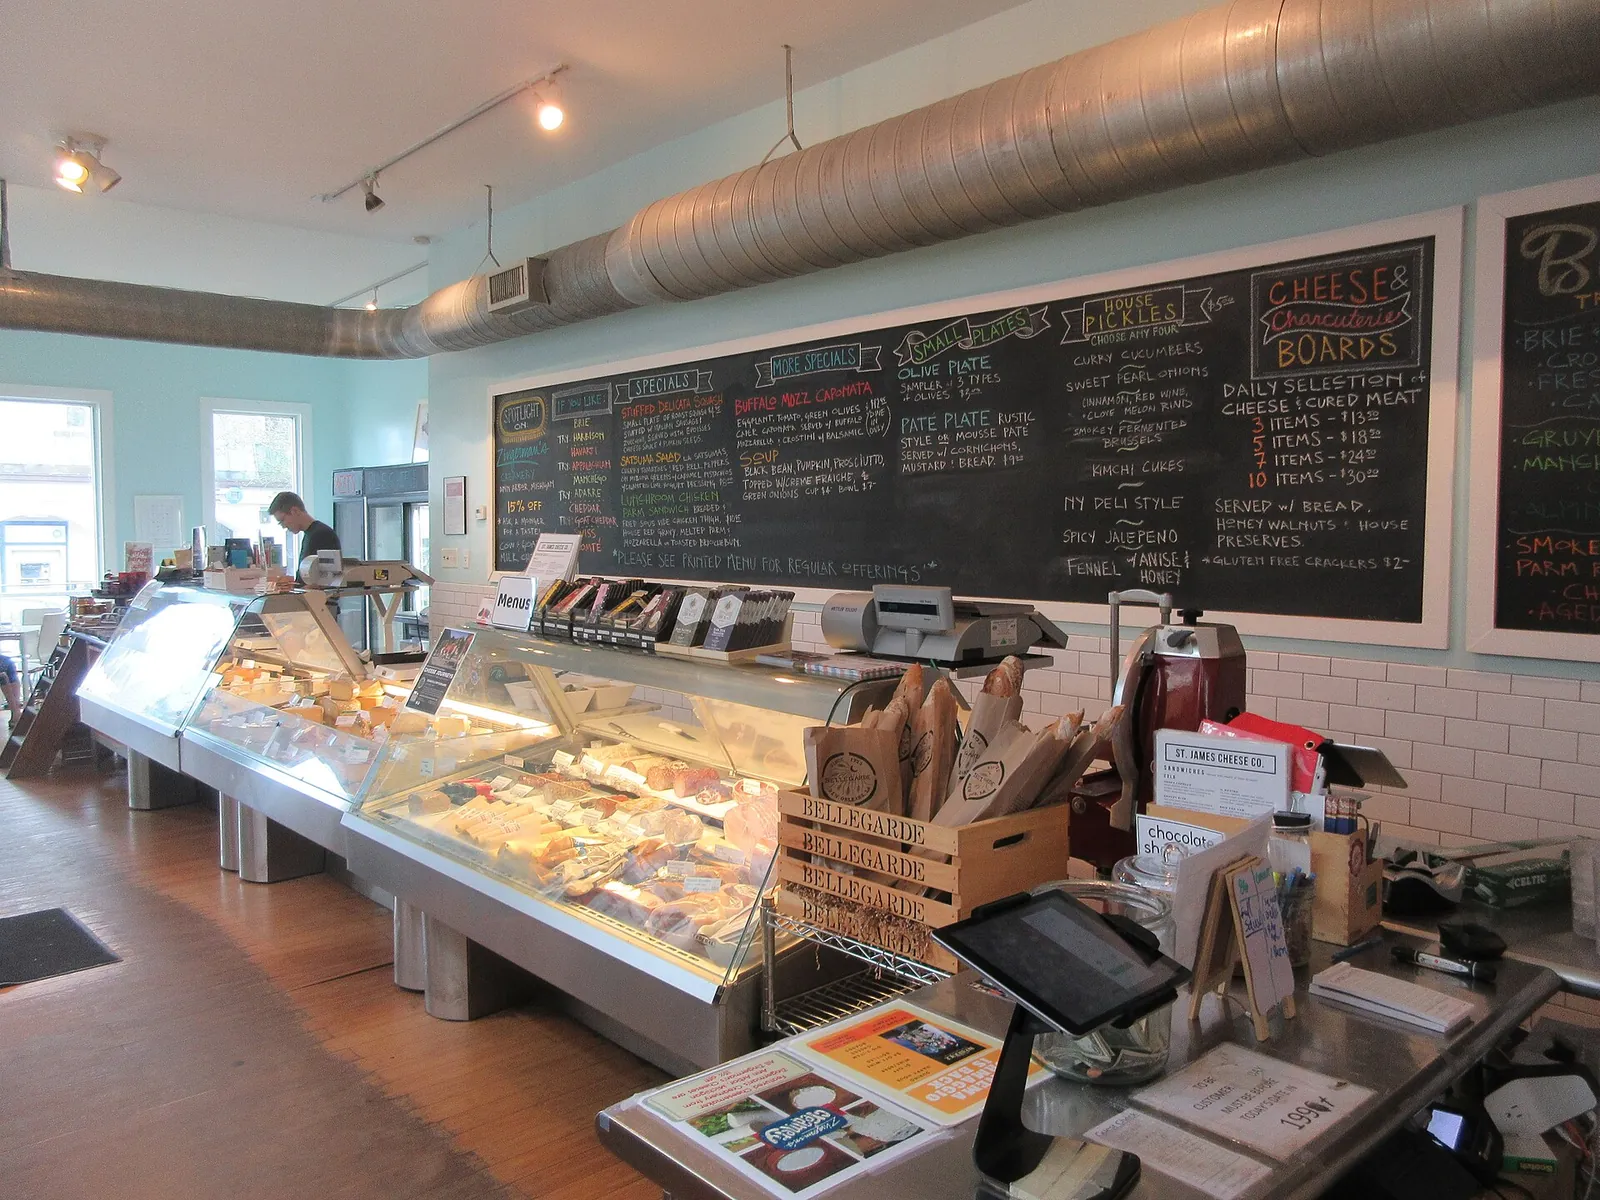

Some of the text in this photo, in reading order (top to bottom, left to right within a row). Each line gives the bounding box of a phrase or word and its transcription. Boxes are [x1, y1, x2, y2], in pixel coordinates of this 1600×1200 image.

[1270, 265, 1408, 305] CHEESE &
[1104, 294, 1153, 312] HOUSE
[1086, 304, 1176, 330] PICKLES
[914, 312, 1026, 361] SMALL PLATES
[1091, 325, 1179, 346] CHOOSE ANY FOUR
[1074, 342, 1204, 366] CURRY CUCUMBERS
[1278, 333, 1397, 368] BOARDS
[773, 348, 855, 375] MORE SPECIALS
[898, 356, 991, 380] OLIVE PLATE
[636, 373, 689, 395] SPECIALS
[900, 374, 1000, 393] SAMPLER 3 TYPES
[1066, 367, 1208, 392] SWEET PEARL ONIONS
[1224, 373, 1403, 397] DAILY SELECTION
[558, 401, 565, 409] IF
[735, 382, 872, 415] BUFFALO MOZZ CAPONATA
[915, 390, 950, 402] OLIVES
[1135, 393, 1155, 403] RED
[1221, 388, 1423, 416] CHEESE CURED MEAT
[504, 402, 540, 423] SPOTLIGHT
[621, 404, 655, 419] STUFFED
[658, 398, 691, 413] DELICATA
[805, 405, 860, 420] GREEN OLIVES
[1125, 400, 1192, 415] MELON RIND
[902, 410, 1035, 434] PATÉ PLATE RUSTIC
[1073, 420, 1187, 436] SMOKEY FERMENTED
[1252, 413, 1320, 433] 3 ITEMS
[783, 429, 863, 444] CROSTINI BALSAMIC
[901, 435, 932, 448] STYLE
[956, 428, 997, 442] MOUSSE
[1104, 434, 1163, 448] BRUSSELS
[1252, 432, 1320, 452] 5 ITEMS
[620, 452, 681, 466] SATSUMA SALAD
[740, 450, 778, 467] SOUP
[902, 450, 934, 461] SERVED
[1254, 450, 1323, 469] 7 ITEMS
[744, 465, 768, 477] BLACK
[902, 462, 946, 472] MUSTARD
[1092, 460, 1184, 477] KIMCHI CUKES
[742, 479, 772, 490] TOPPED
[1249, 470, 1324, 488] 10 ITEMS
[679, 492, 720, 502] CHICKEN
[742, 489, 766, 501] GREEN
[769, 489, 799, 499] ONIONS
[1064, 496, 1183, 511] NY DELI STYLE
[507, 501, 542, 513] 15% OFF
[649, 506, 689, 516] SANDWICH
[1215, 498, 1272, 514] SERVED
[1216, 518, 1408, 531] HONEY WALNUTS HOUSE
[1063, 529, 1178, 544] SPICY JALEPENO
[658, 553, 675, 568] SEE
[682, 552, 721, 569] PRINTED
[727, 553, 756, 571] MENU
[762, 558, 784, 573] FOR
[789, 559, 837, 576] REGULAR
[1067, 551, 1182, 576] FENNEL ANISE
[1270, 556, 1377, 569] FREE CRACKERS
[1517, 559, 1578, 577] PARM
[1140, 569, 1181, 585] HONEY
[498, 594, 530, 610] Menus
[1176, 749, 1264, 768] ST. JAMES CHEESE CO.
[1164, 765, 1204, 775] SANDWICHES
[802, 798, 926, 846] BELLEGARDE
[802, 833, 926, 883] BELLEGARDE
[802, 867, 926, 923] BELLEGARDE
